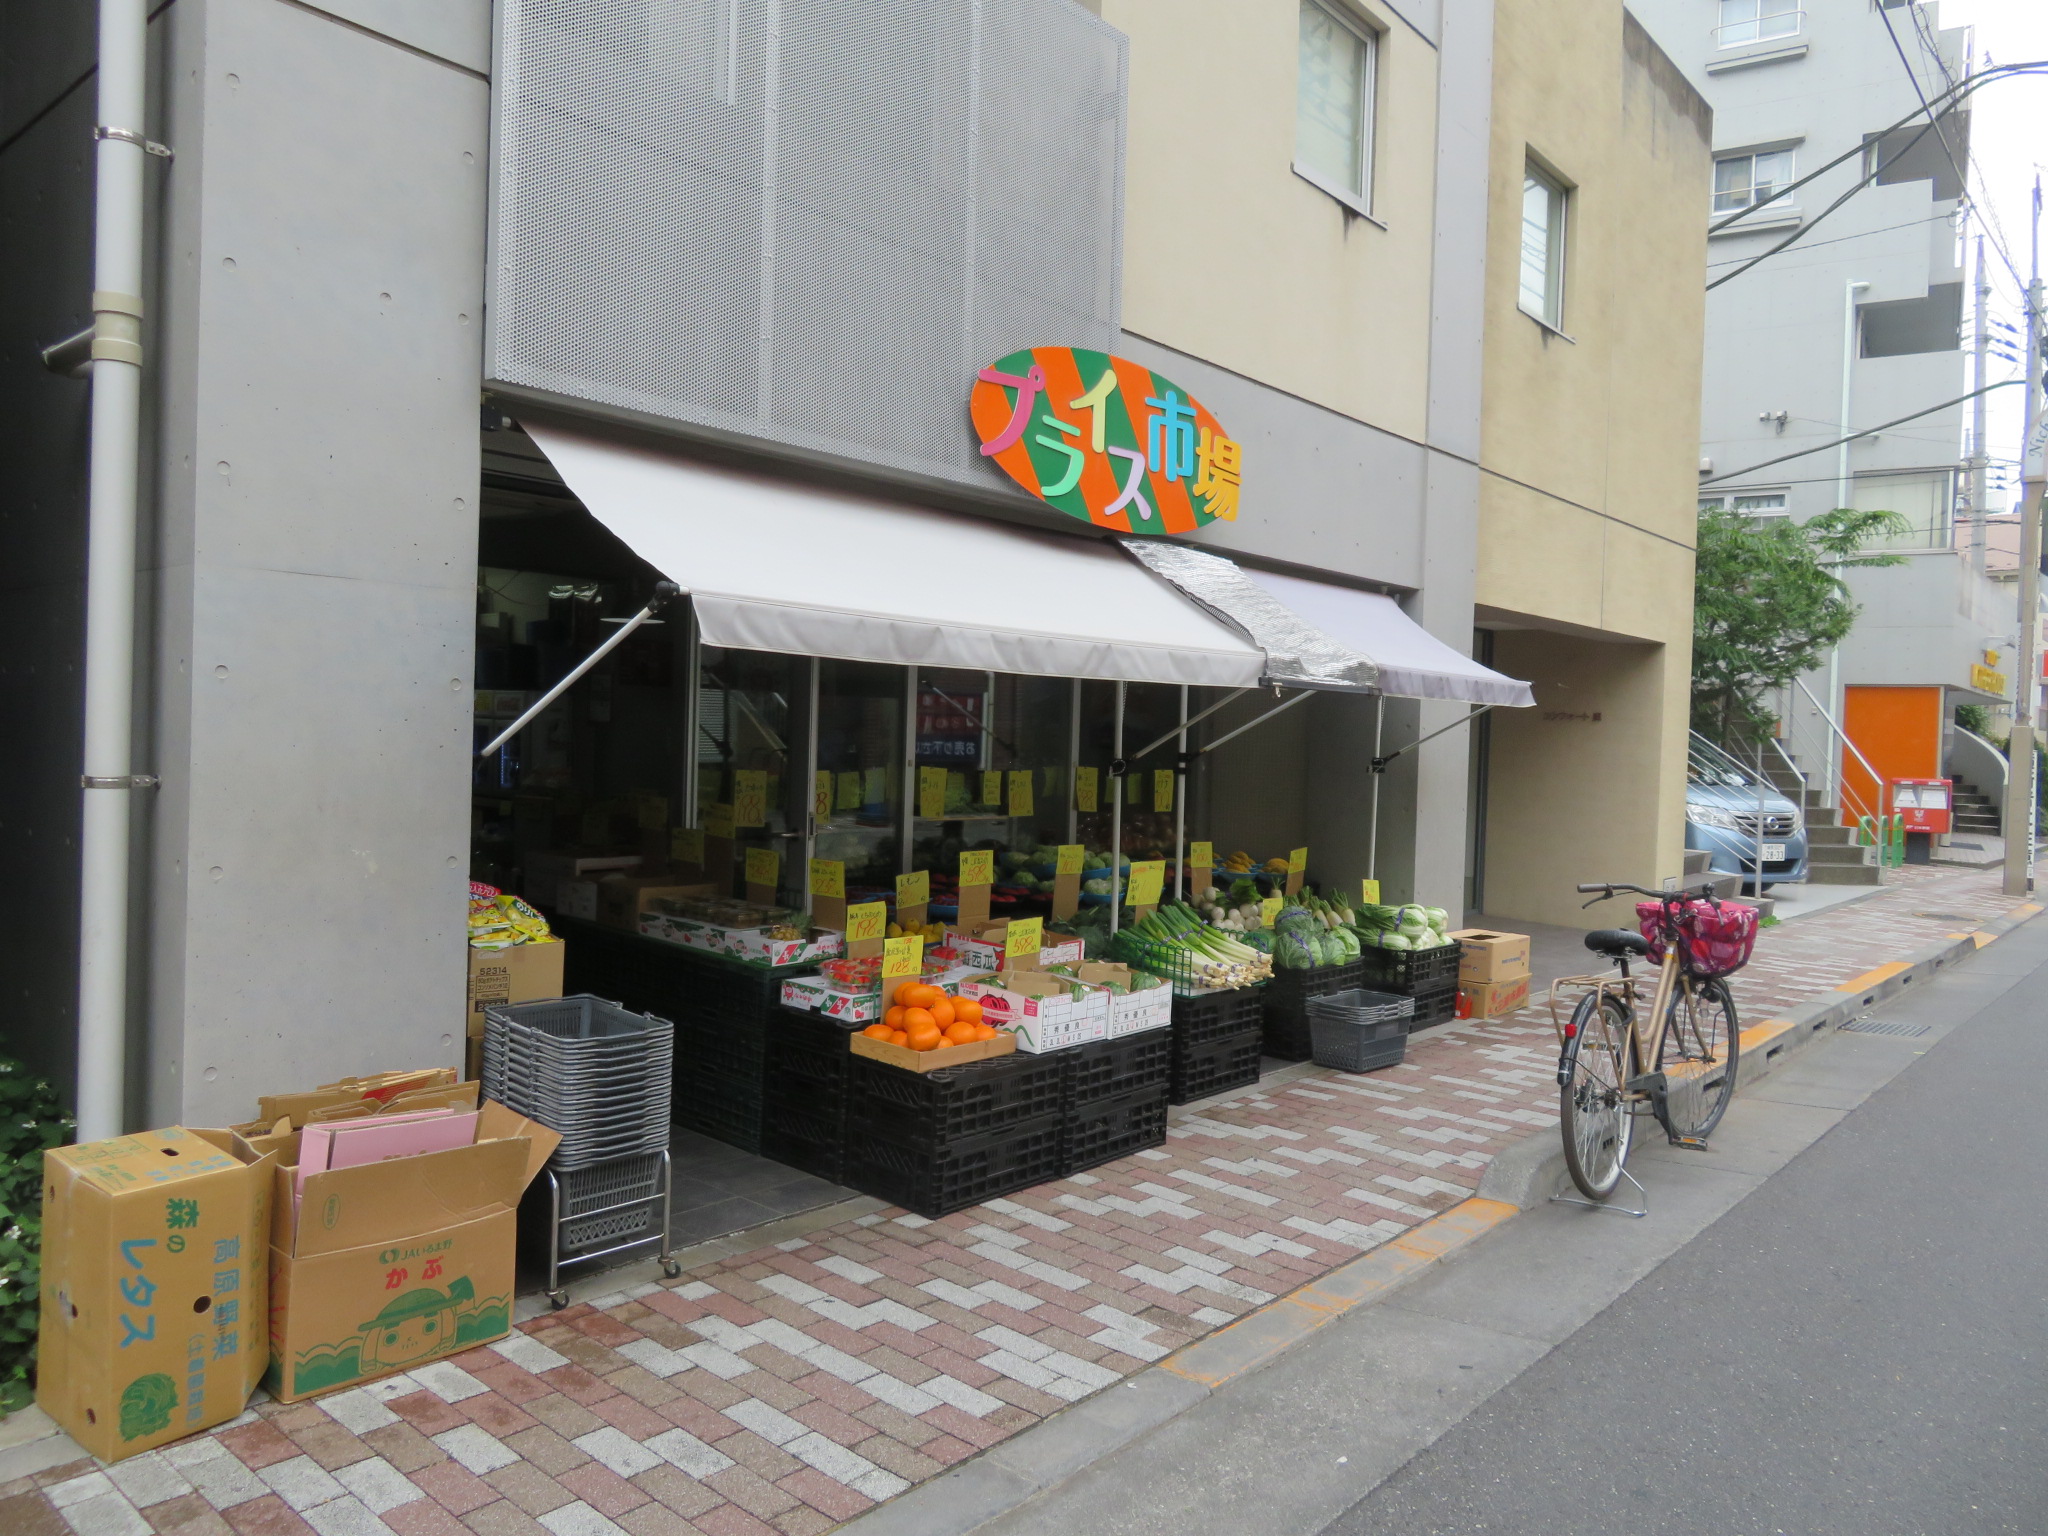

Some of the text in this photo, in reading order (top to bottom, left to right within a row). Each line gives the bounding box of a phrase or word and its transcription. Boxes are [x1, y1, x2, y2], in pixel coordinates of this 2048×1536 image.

[978, 365, 1242, 522] プライス市場
[966, 863, 987, 883] 598
[856, 916, 878, 939] 198
[1013, 935, 1033, 954] 598
[480, 966, 507, 976] 52314
[890, 960, 910, 974] 128
[385, 1256, 444, 1289] かぶ
[118, 1238, 158, 1349] レタス
[212, 1233, 241, 1361] 高原野菜
